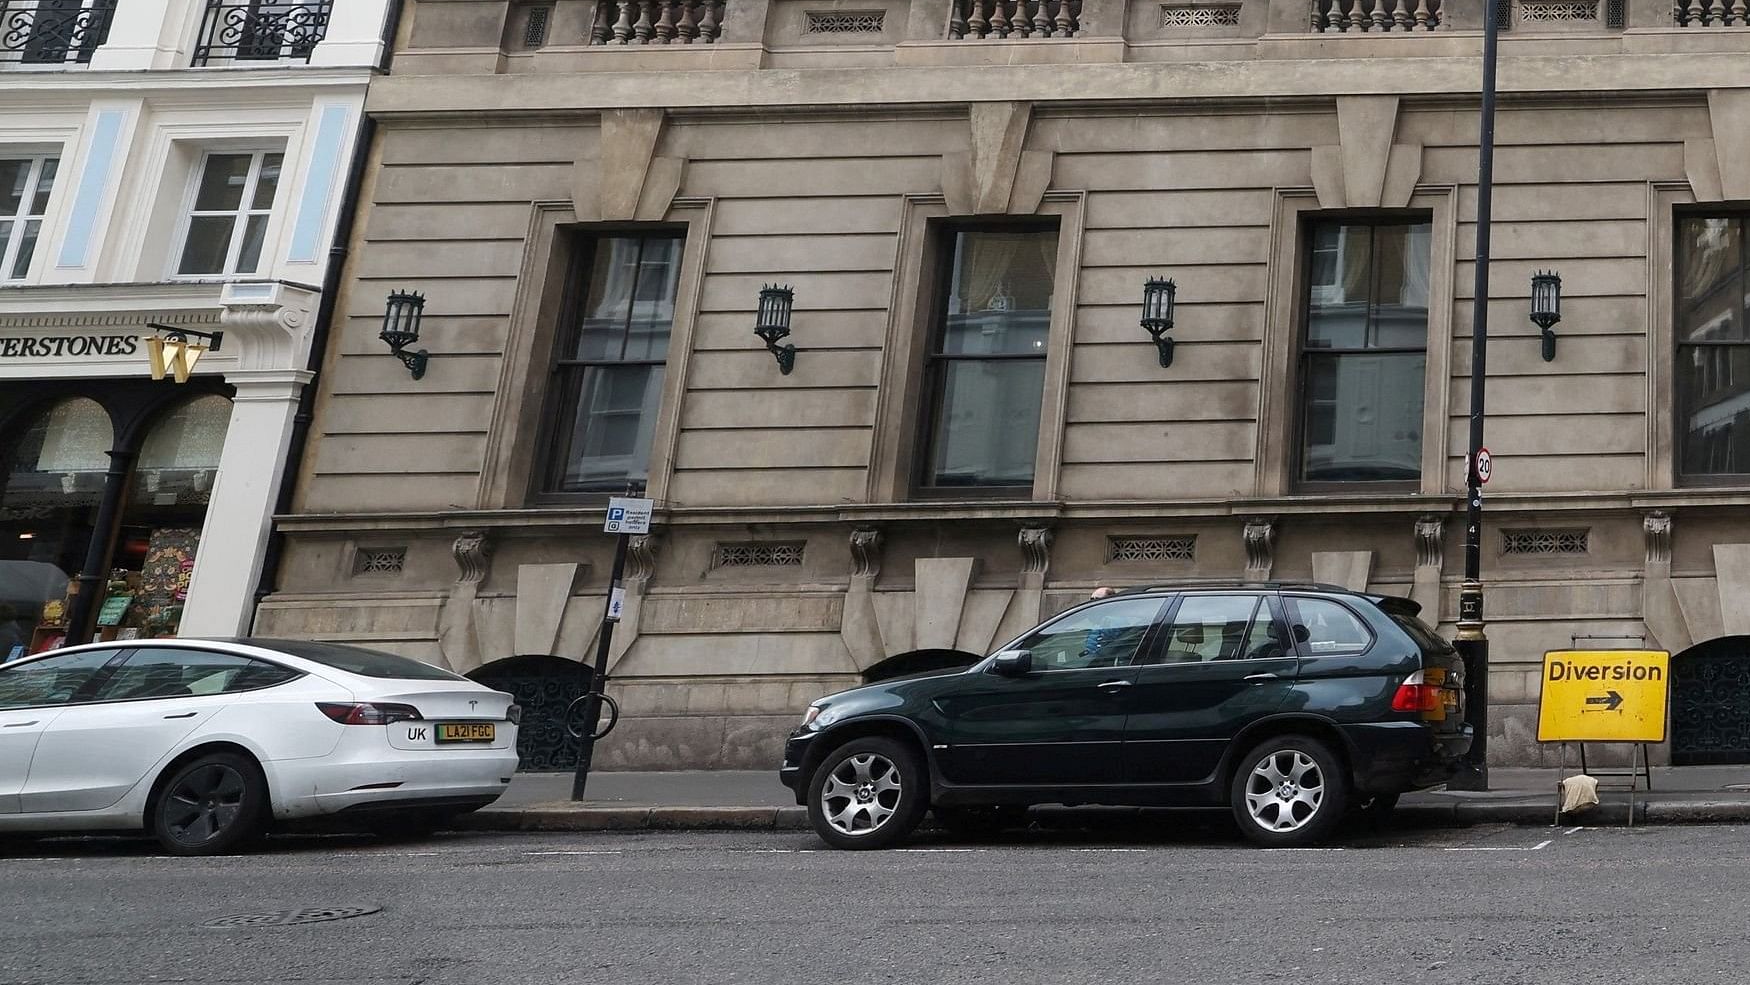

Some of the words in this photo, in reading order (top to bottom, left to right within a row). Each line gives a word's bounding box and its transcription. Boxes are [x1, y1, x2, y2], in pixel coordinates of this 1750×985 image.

[0, 335, 139, 357] ERSTONES
[1479, 458, 1490, 474] 20
[1469, 525, 1476, 534] 4
[1549, 660, 1662, 682] Diversion
[407, 727, 427, 741] UK
[446, 725, 471, 738] LA21
[472, 724, 491, 737] FGC
